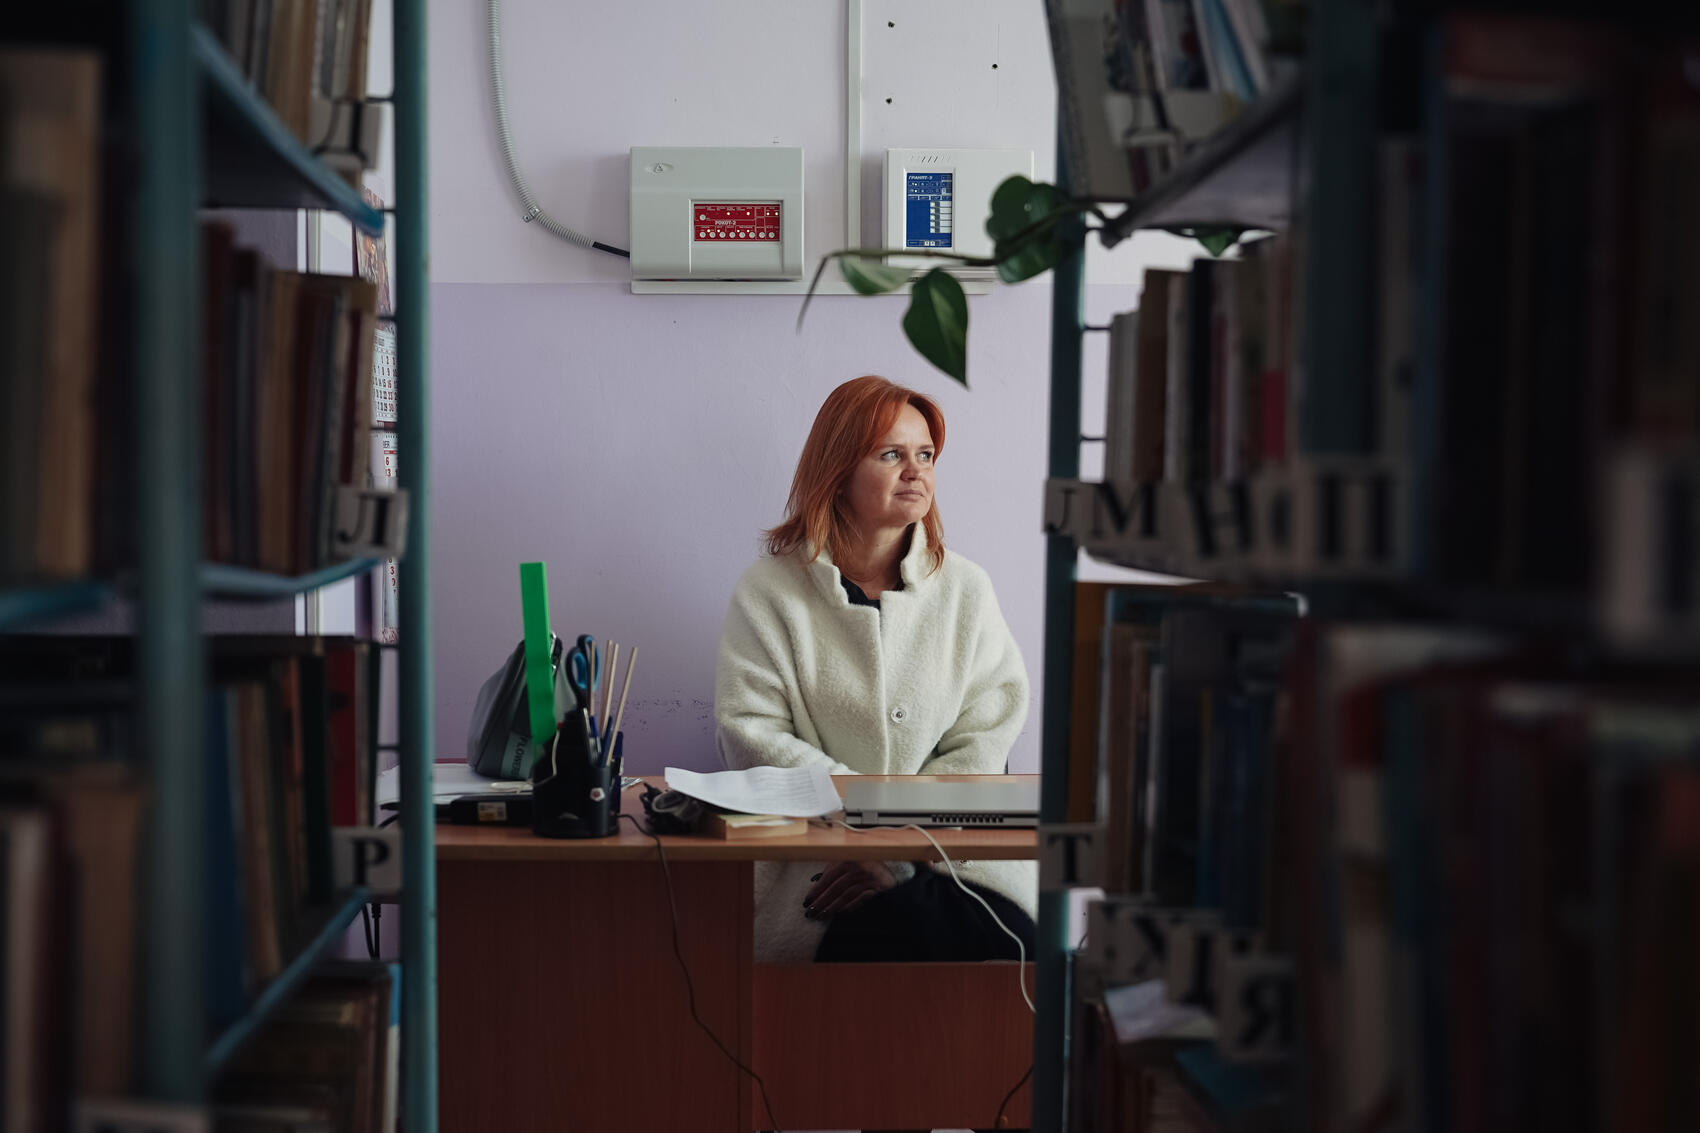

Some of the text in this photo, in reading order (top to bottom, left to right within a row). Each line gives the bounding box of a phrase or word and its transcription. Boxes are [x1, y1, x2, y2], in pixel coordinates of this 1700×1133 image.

[385, 456, 390, 466] 6
[351, 836, 389, 885] Р
[1047, 832, 1092, 884] Т
